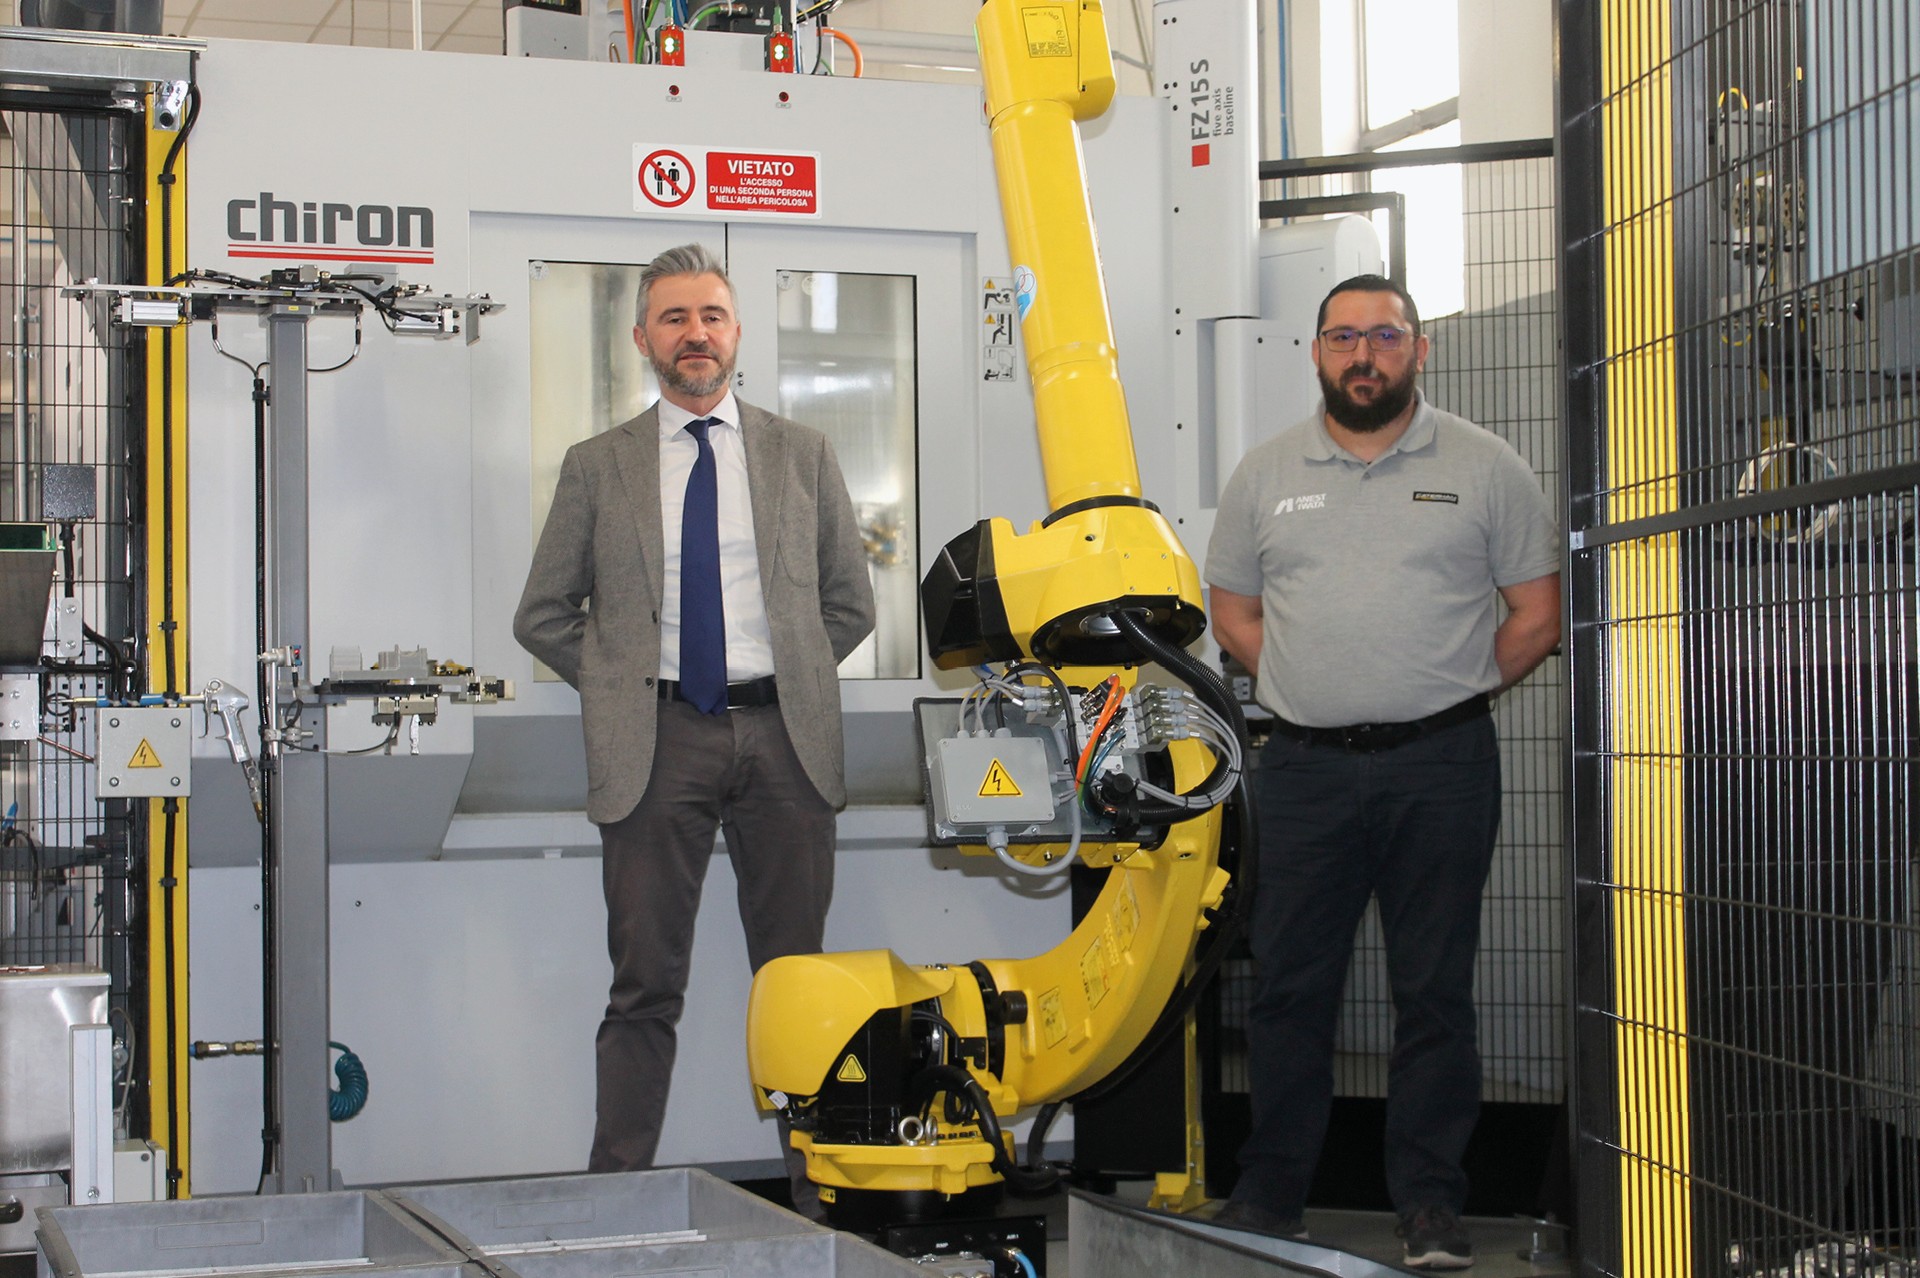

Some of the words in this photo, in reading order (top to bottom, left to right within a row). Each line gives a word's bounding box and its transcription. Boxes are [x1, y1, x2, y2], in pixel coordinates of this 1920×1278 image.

[1212, 88, 1222, 111] axis
[1224, 86, 1234, 136] baseline
[1213, 115, 1222, 137] five
[727, 160, 795, 177] VIETATO
[740, 177, 783, 187] L'ACCESSO
[710, 185, 718, 194] DI
[720, 186, 736, 194] UNA
[738, 187, 775, 196] SECONDA
[777, 189, 814, 198] PERSONA
[716, 195, 757, 205] NELL'AREA
[759, 197, 808, 207] PERICOLOSA
[227, 192, 434, 248] chiron
[1295, 493, 1327, 504] ANEST
[1297, 501, 1325, 510] IWATA
